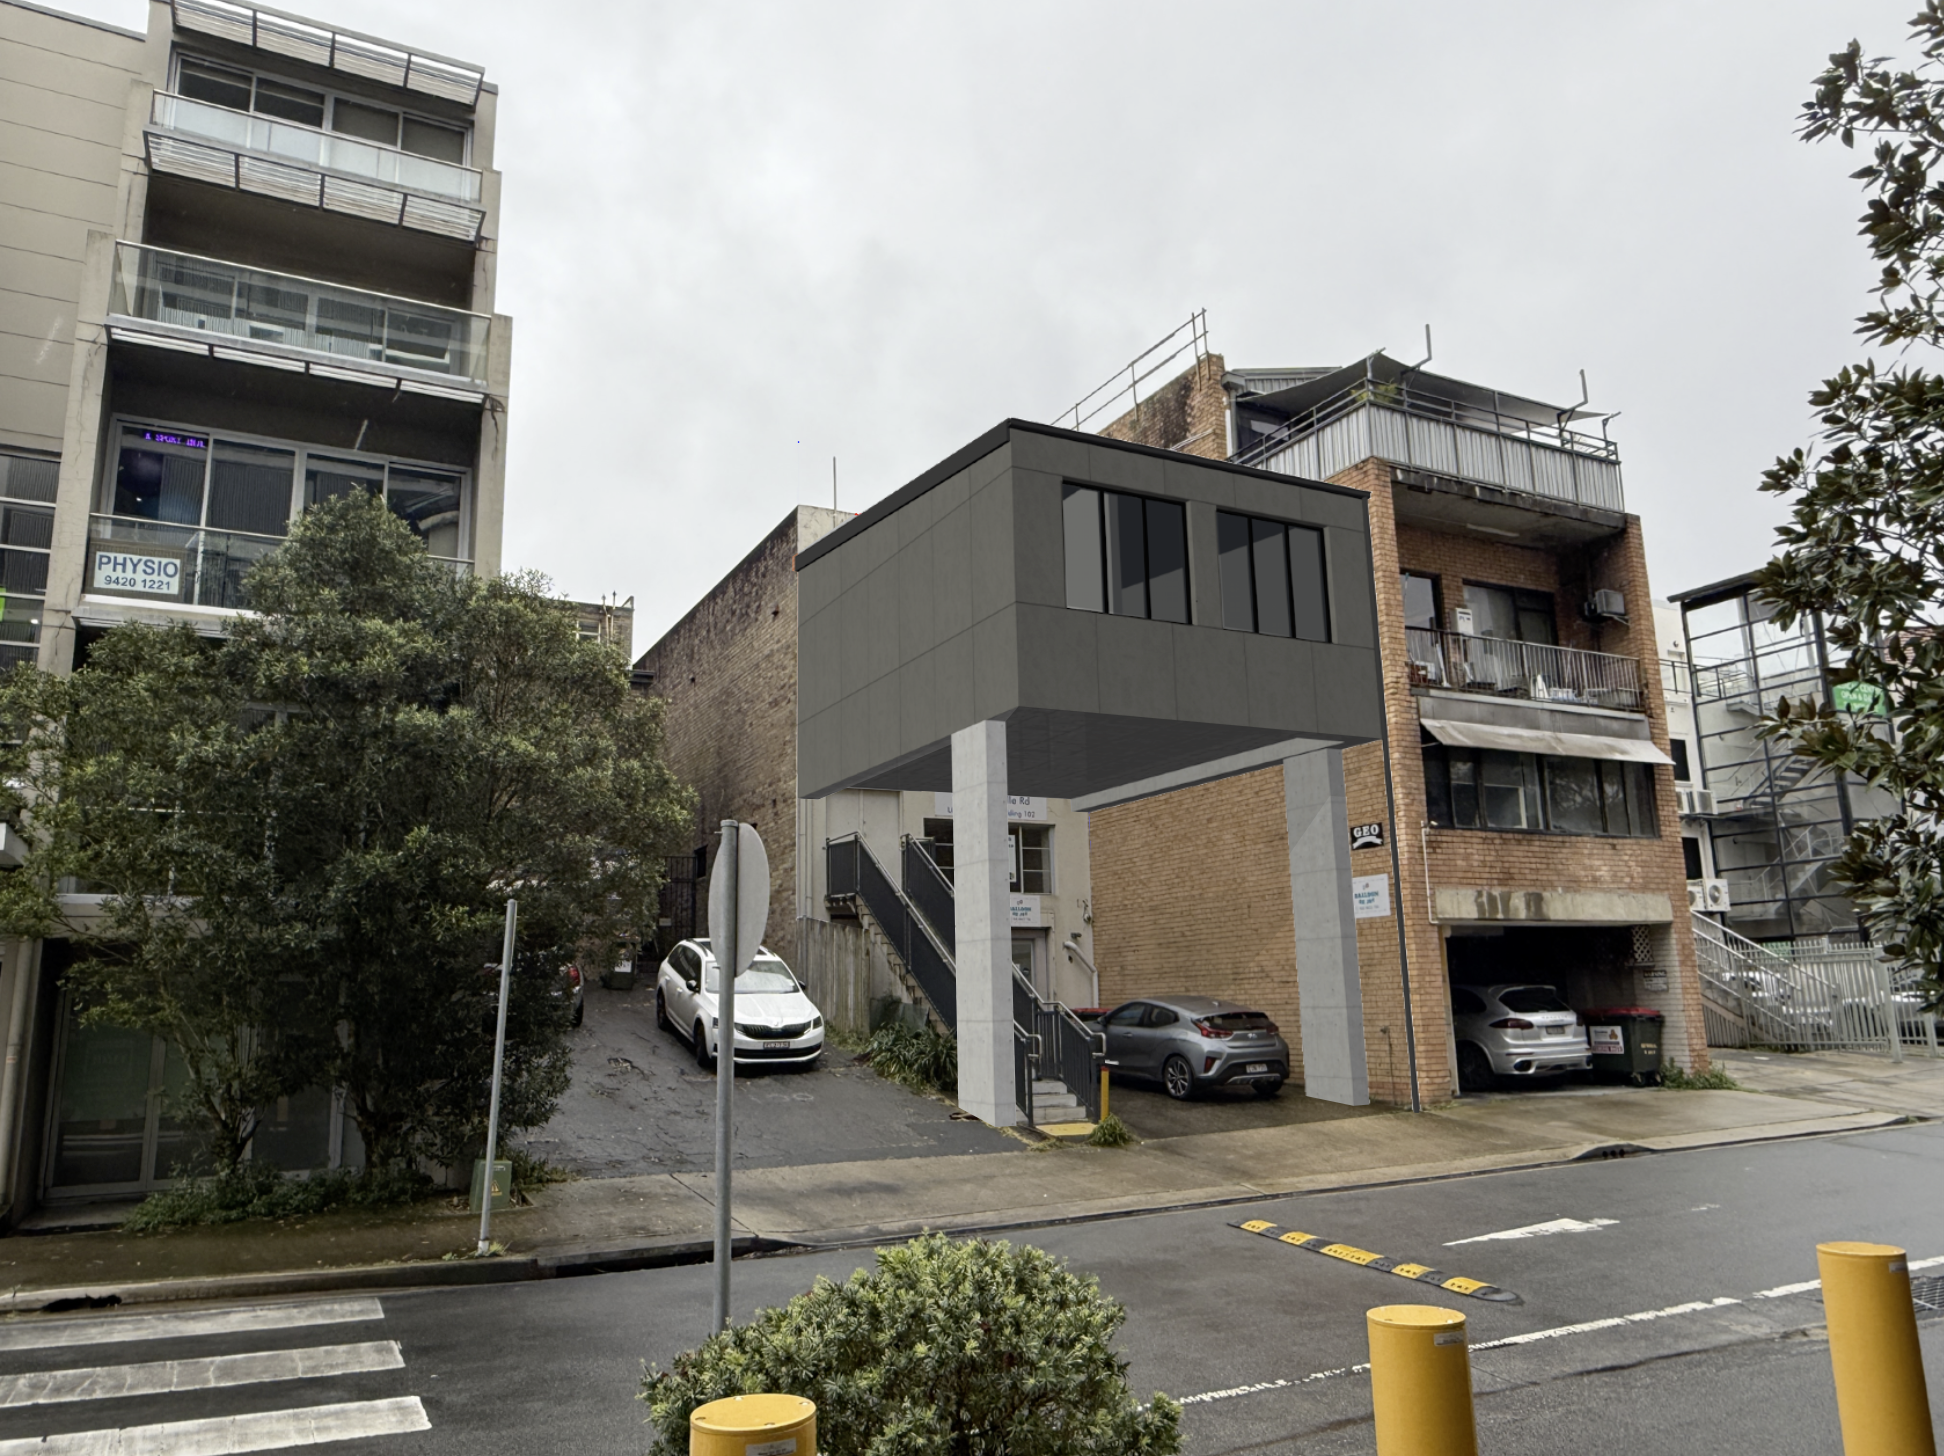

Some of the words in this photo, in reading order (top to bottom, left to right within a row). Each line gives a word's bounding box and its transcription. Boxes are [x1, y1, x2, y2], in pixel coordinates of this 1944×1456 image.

[98, 554, 179, 579] PHYSIO
[104, 575, 136, 588] 9420
[141, 578, 171, 591] 1221
[1019, 796, 1030, 806] Rd
[1353, 824, 1379, 838] GEO
